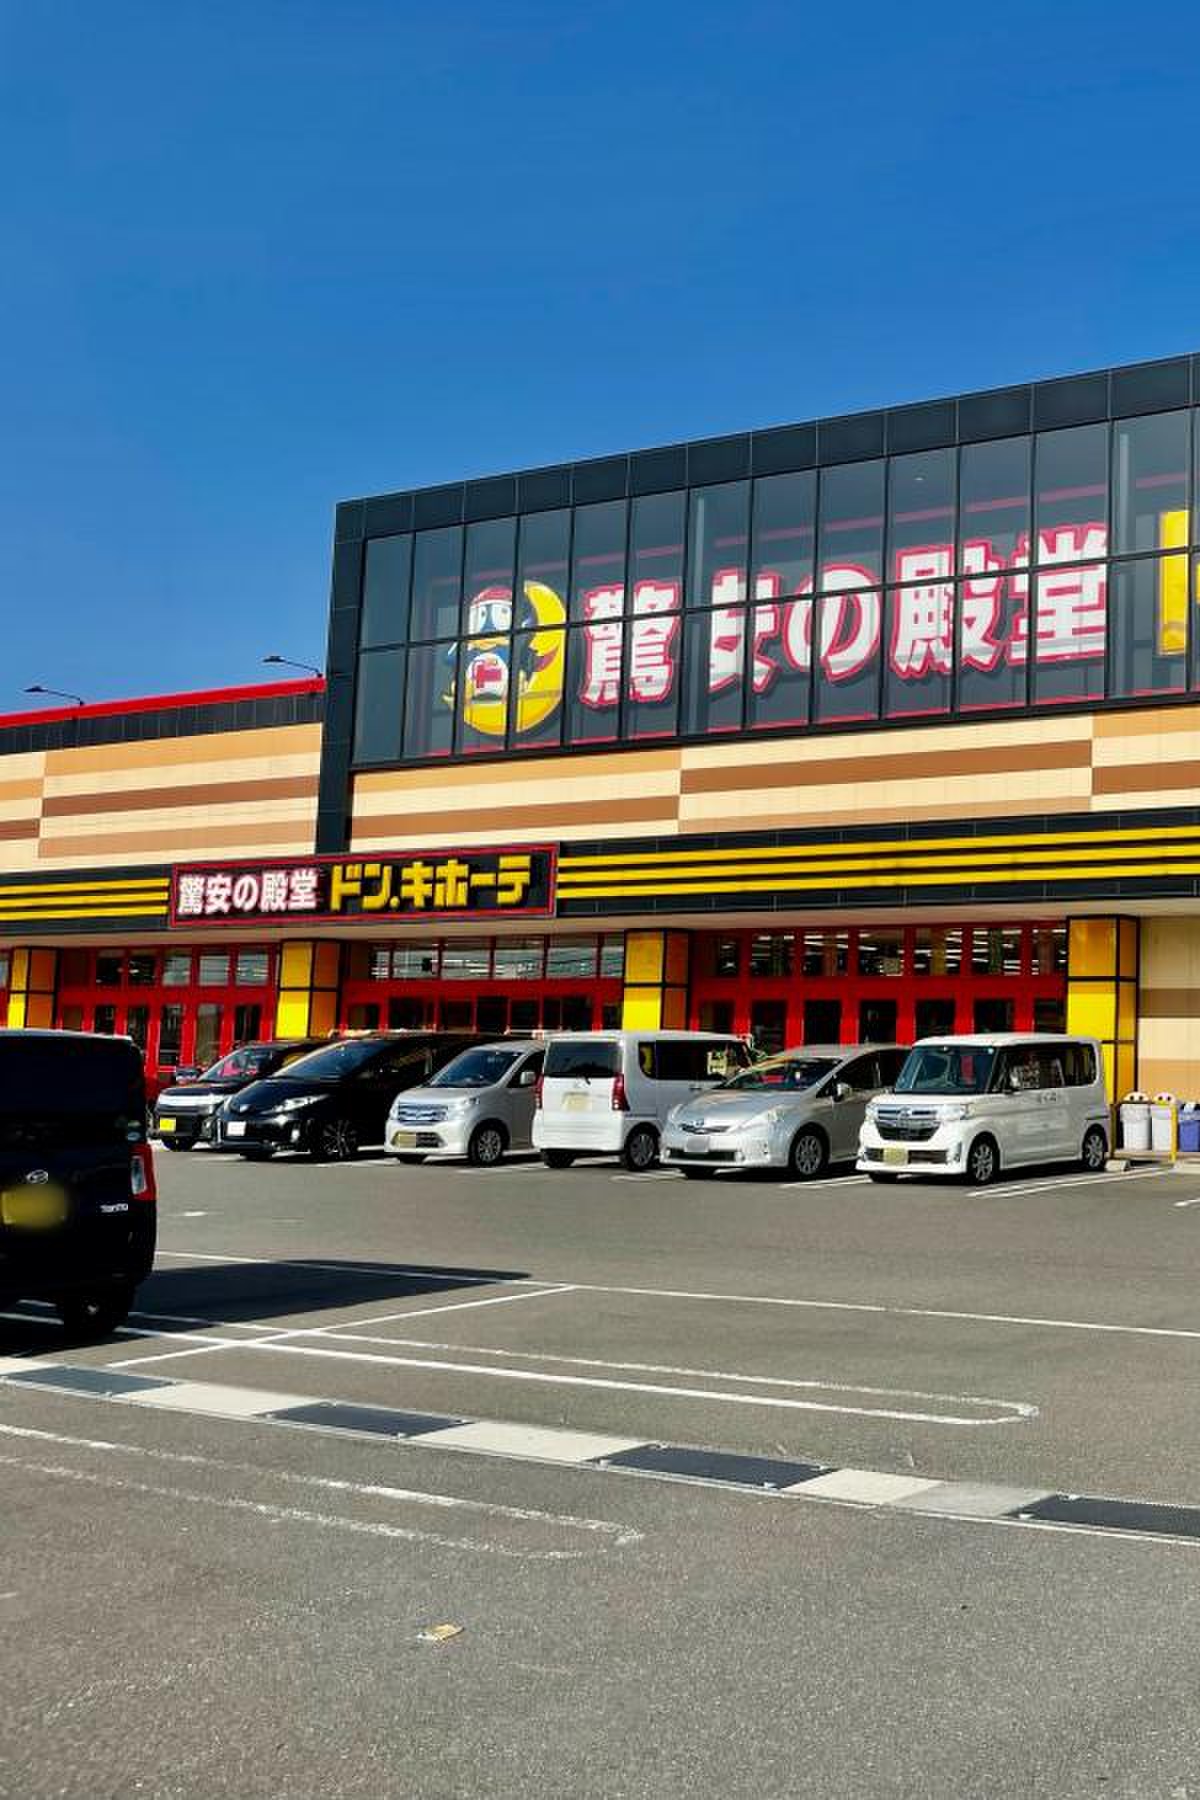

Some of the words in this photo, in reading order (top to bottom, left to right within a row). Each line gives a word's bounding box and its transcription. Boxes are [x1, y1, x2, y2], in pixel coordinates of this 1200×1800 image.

[178, 869, 318, 914] 驚安の殿堂
